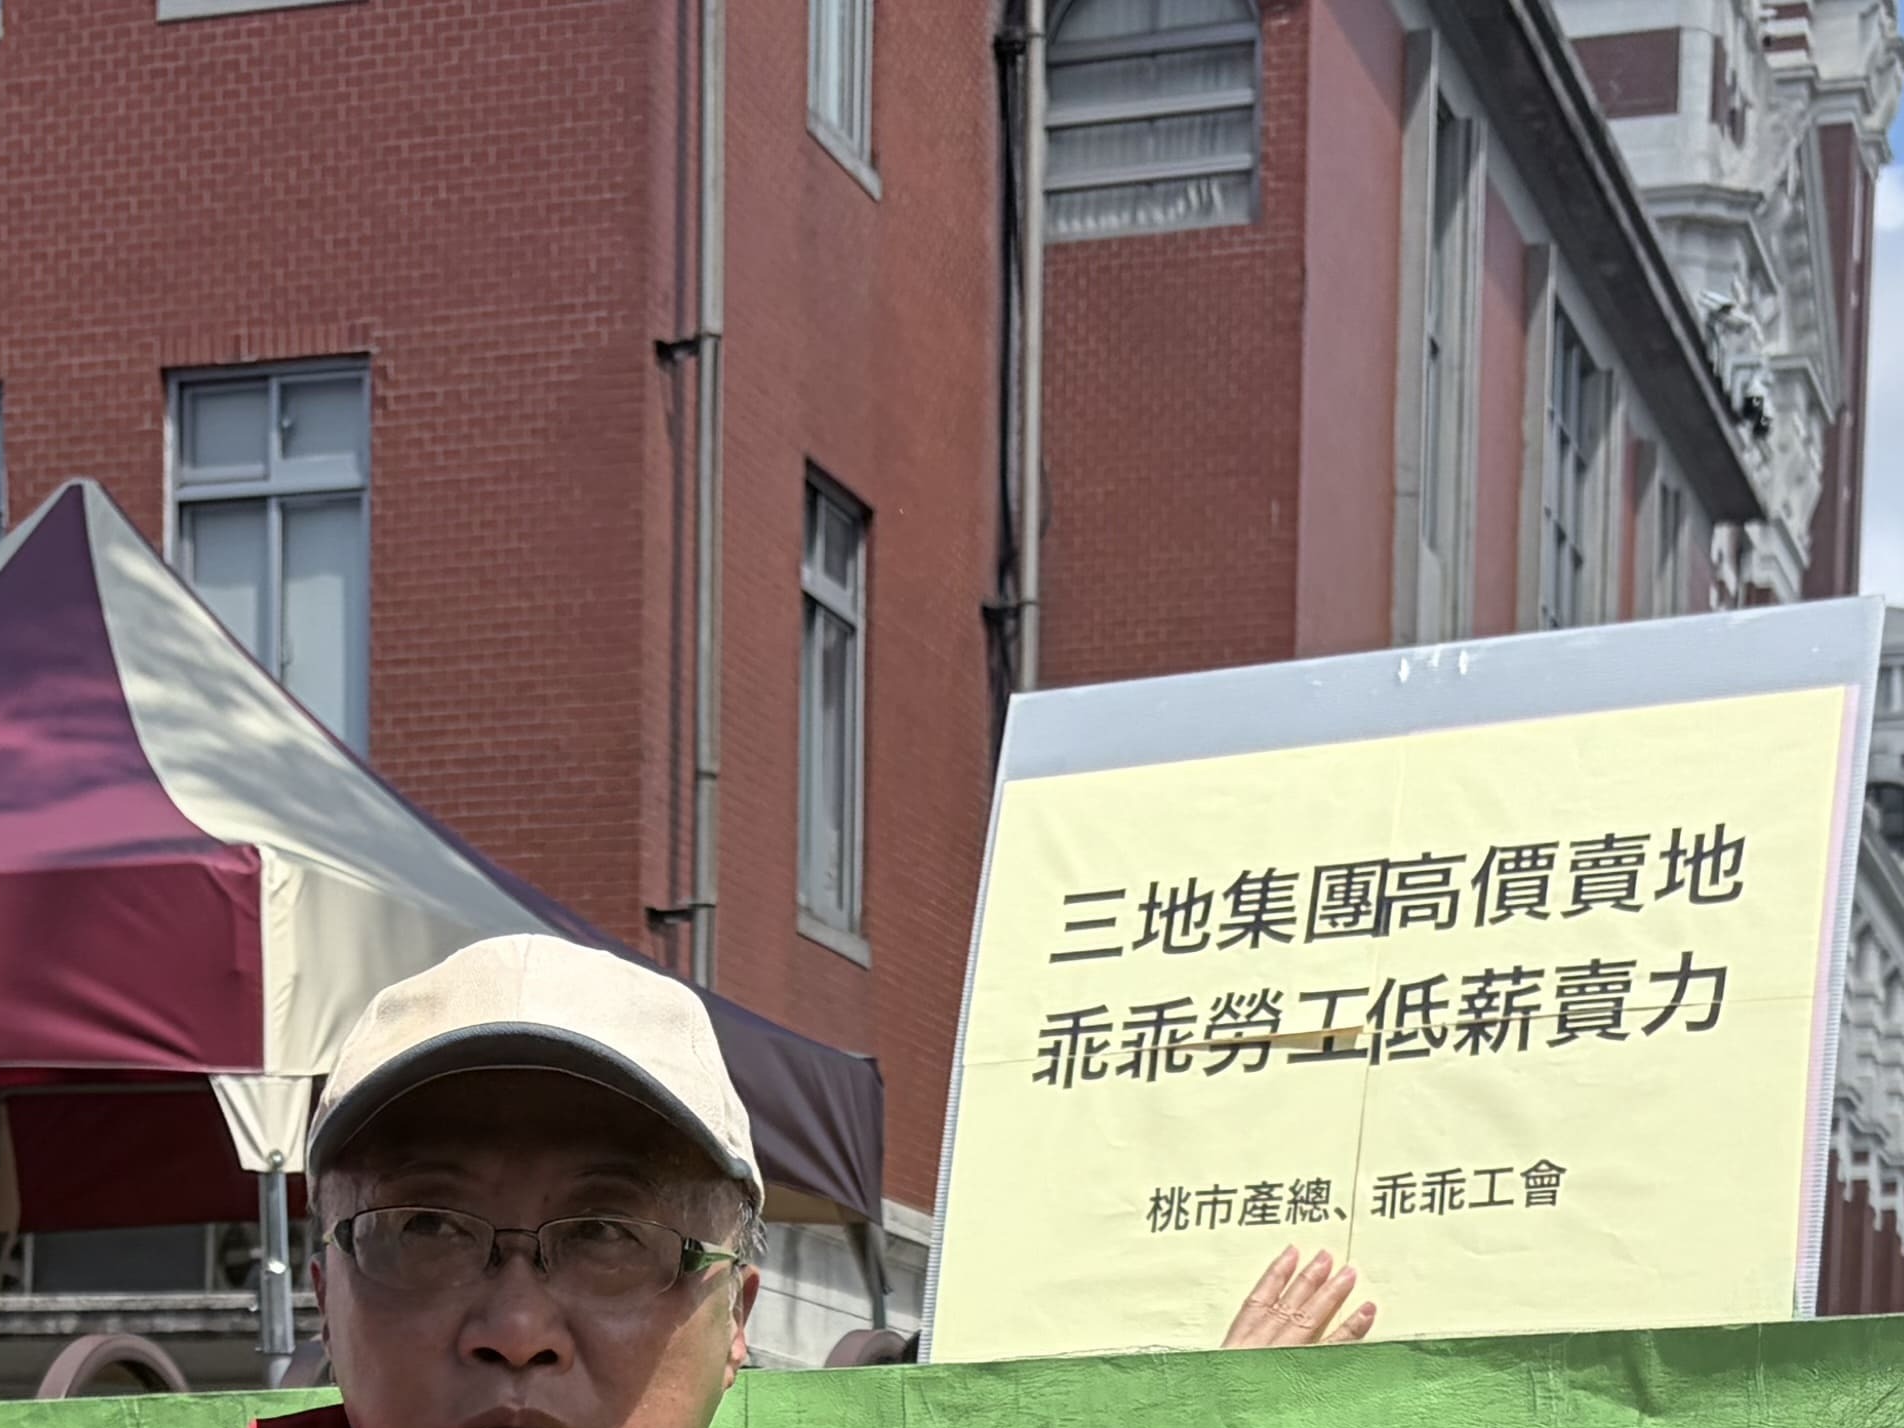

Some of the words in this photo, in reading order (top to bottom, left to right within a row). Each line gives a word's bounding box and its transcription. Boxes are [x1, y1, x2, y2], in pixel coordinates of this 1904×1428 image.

[1048, 824, 1746, 964] 三地集團高價賣地
[1032, 950, 1728, 1090] 乖乖勞工低薪賣力
[1146, 1158, 1567, 1234] 桃市產總、乖乖工會
